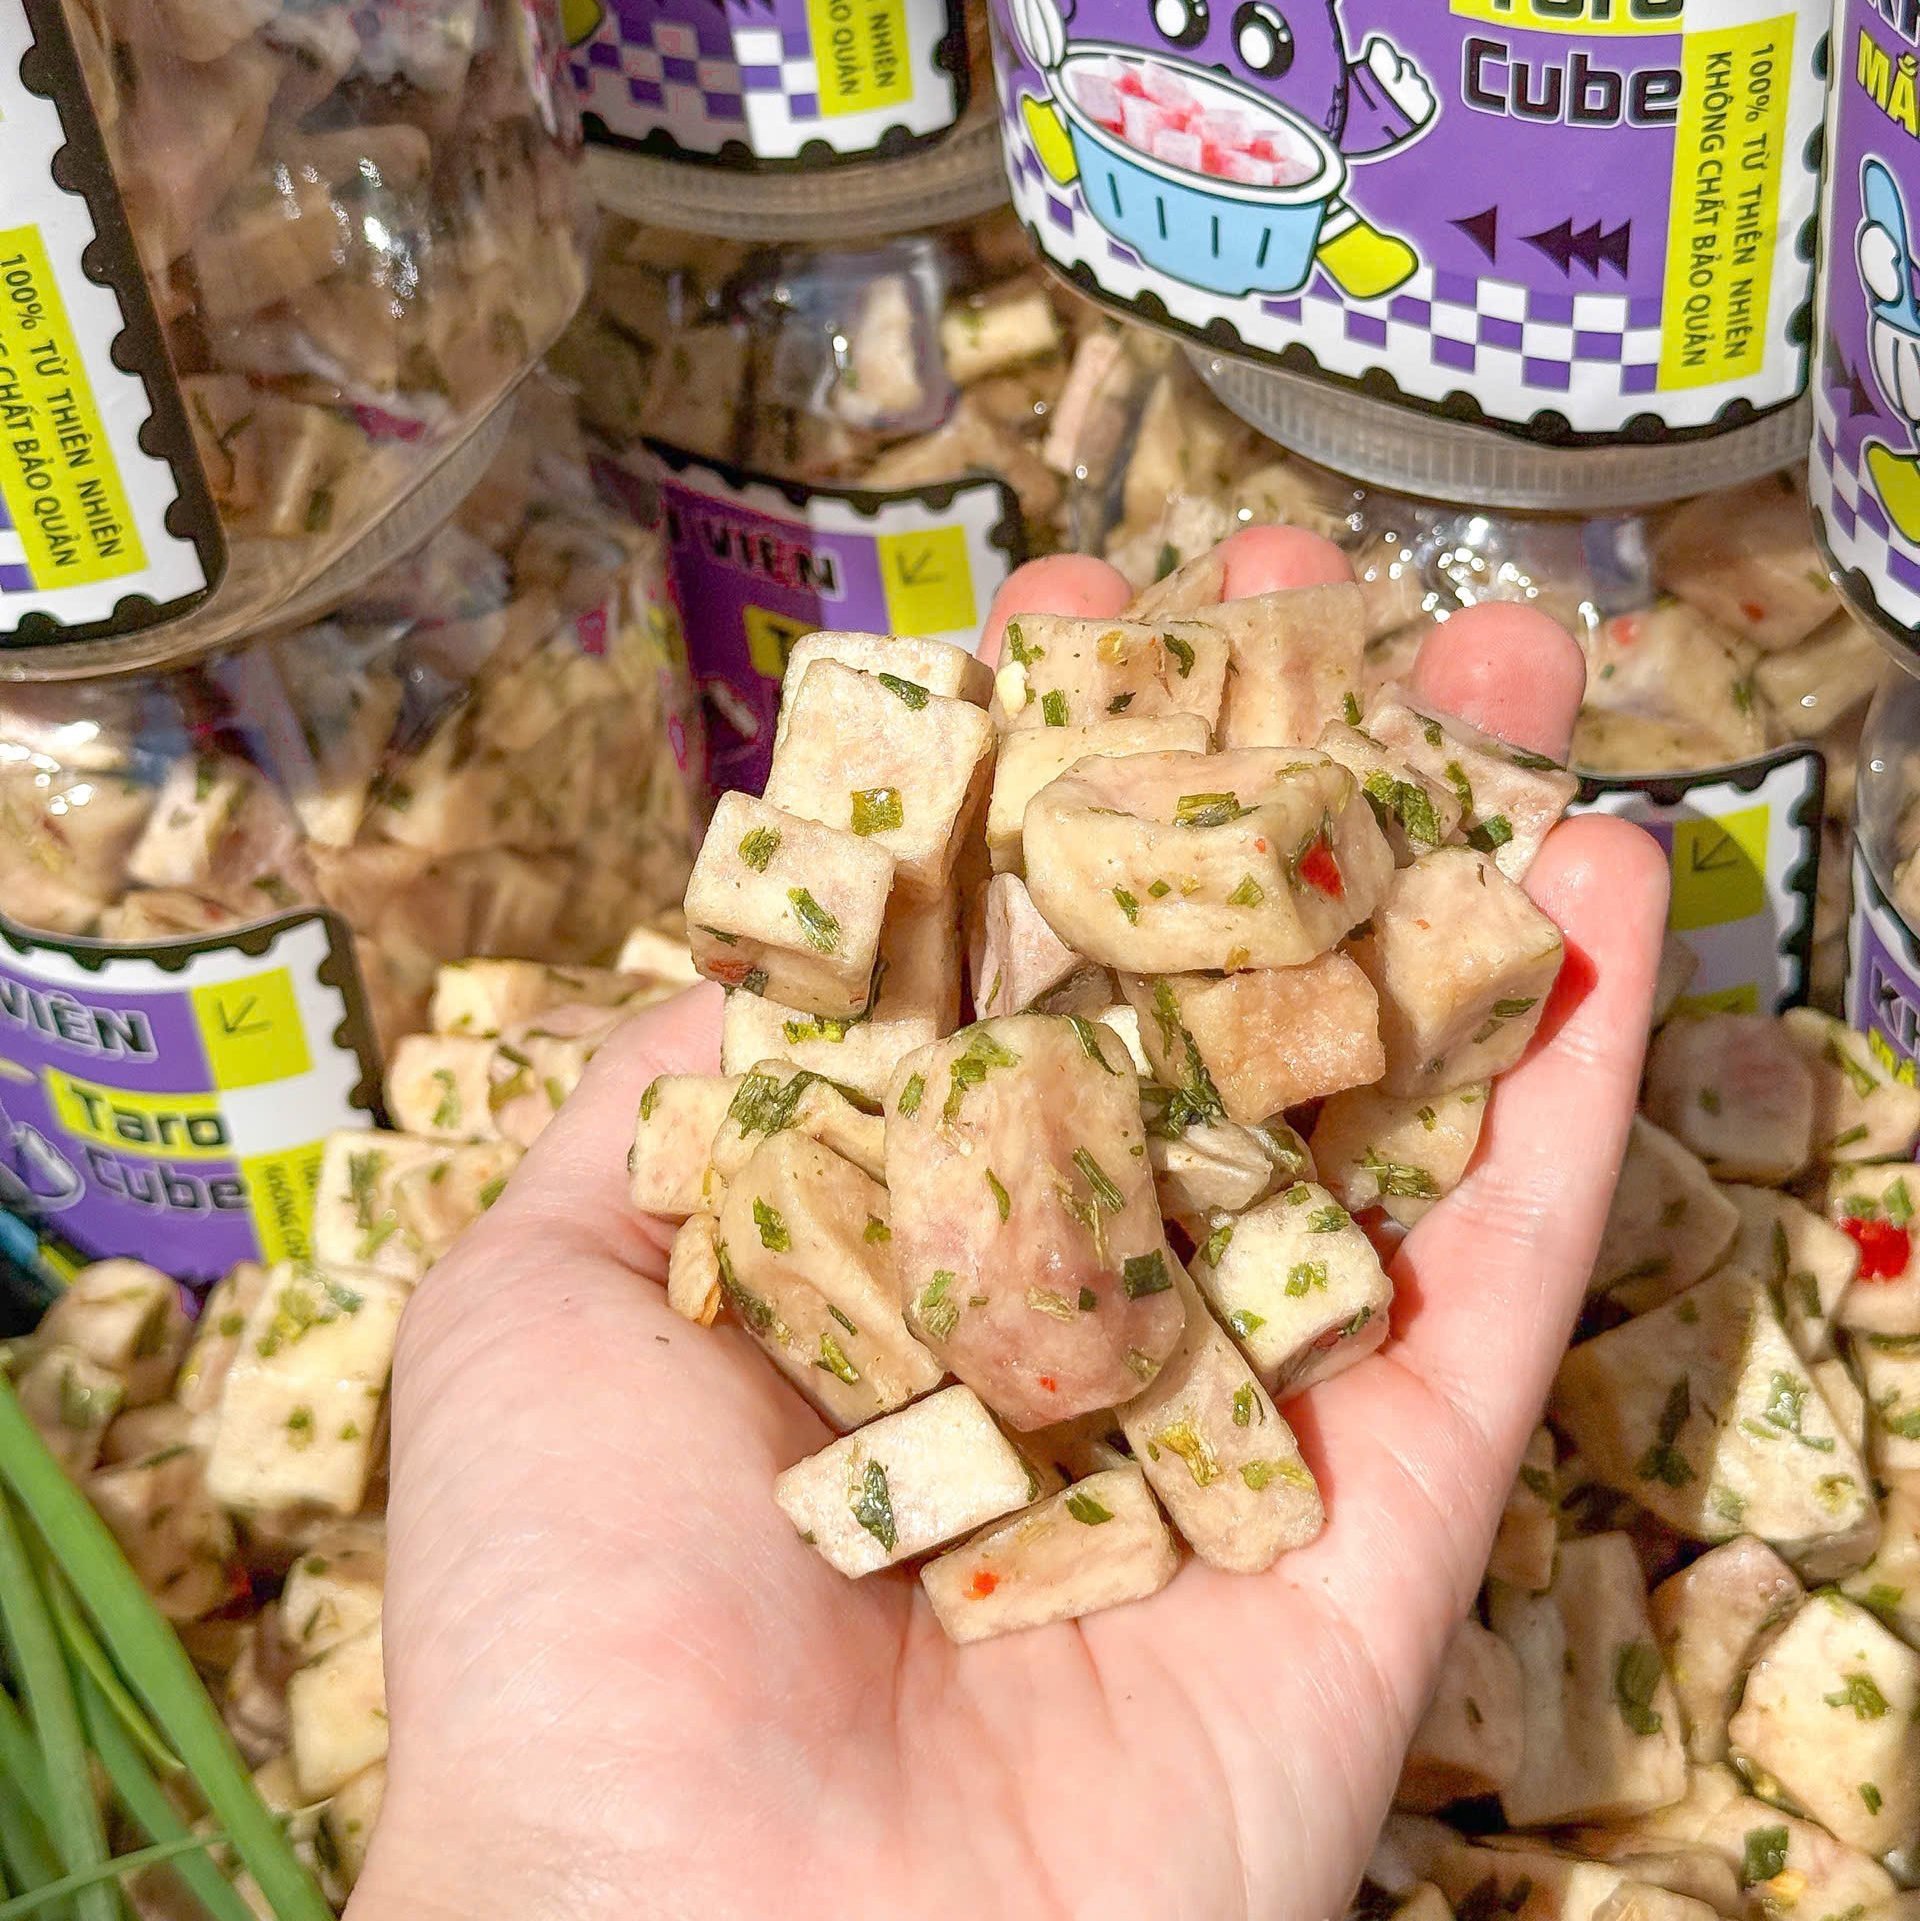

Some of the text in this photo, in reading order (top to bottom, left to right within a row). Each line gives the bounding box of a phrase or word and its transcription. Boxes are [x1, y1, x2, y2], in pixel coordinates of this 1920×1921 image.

[1461, 35, 1683, 128] Cube
[1700, 51, 1734, 154] KHÔNG
[1723, 43, 1774, 359] 100% TỪ THIÊN NHIÊN
[1688, 234, 1722, 288] BẢO
[1682, 294, 1716, 367] QUẢN
[0, 254, 46, 330] 100%
[47, 387, 96, 468] THIÊN
[76, 477, 125, 558] NHIÊN
[13, 438, 56, 491] BẢO
[34, 496, 81, 567] QUẢN
[71, 1081, 230, 1146] Taro
[83, 1144, 251, 1214] Cube
